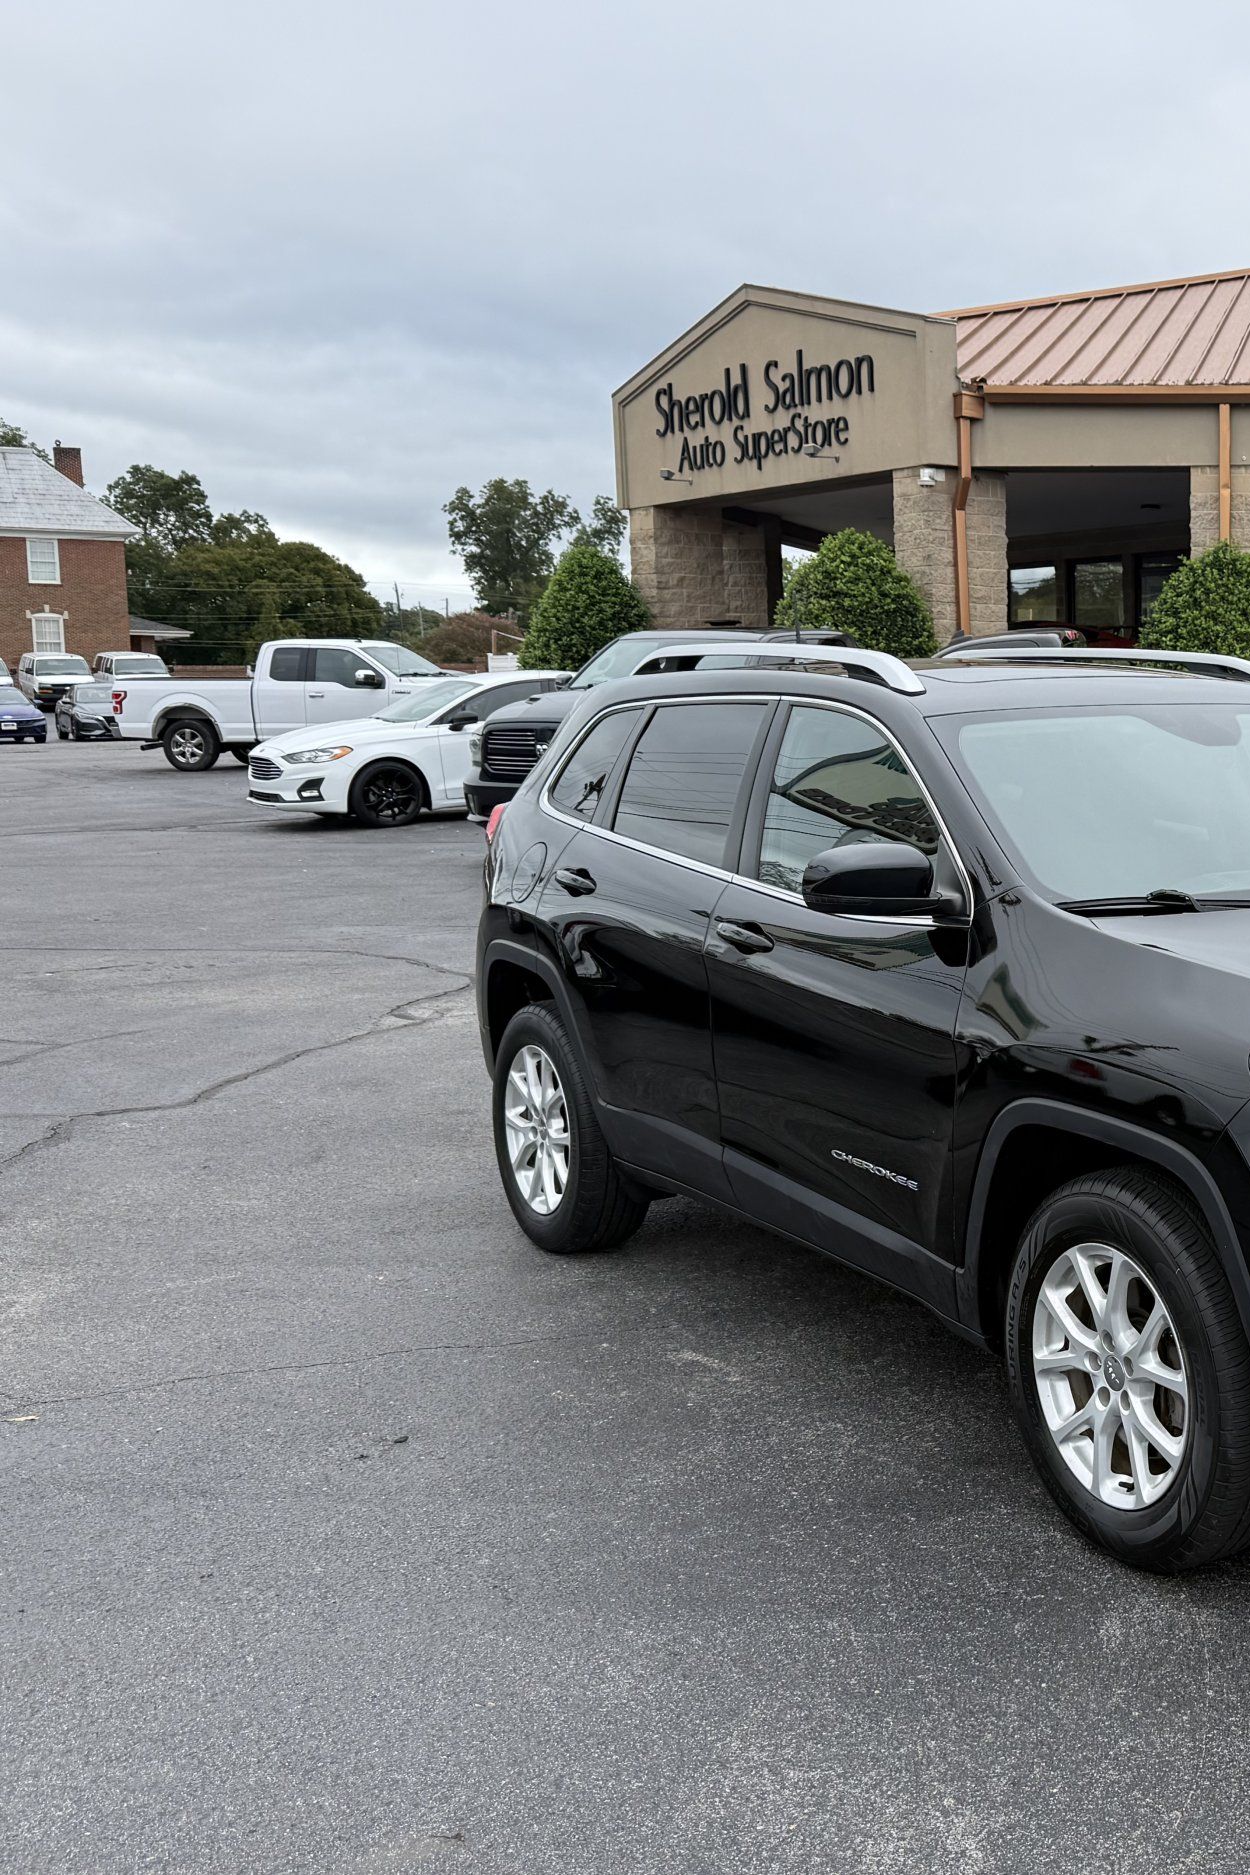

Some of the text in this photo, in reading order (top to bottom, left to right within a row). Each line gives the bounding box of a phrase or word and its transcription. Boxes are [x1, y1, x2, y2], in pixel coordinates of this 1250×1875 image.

[655, 349, 875, 437] Sherold Salmon
[678, 412, 849, 473] Auto SuperStore
[830, 1149, 919, 1192] CHEROKEE
